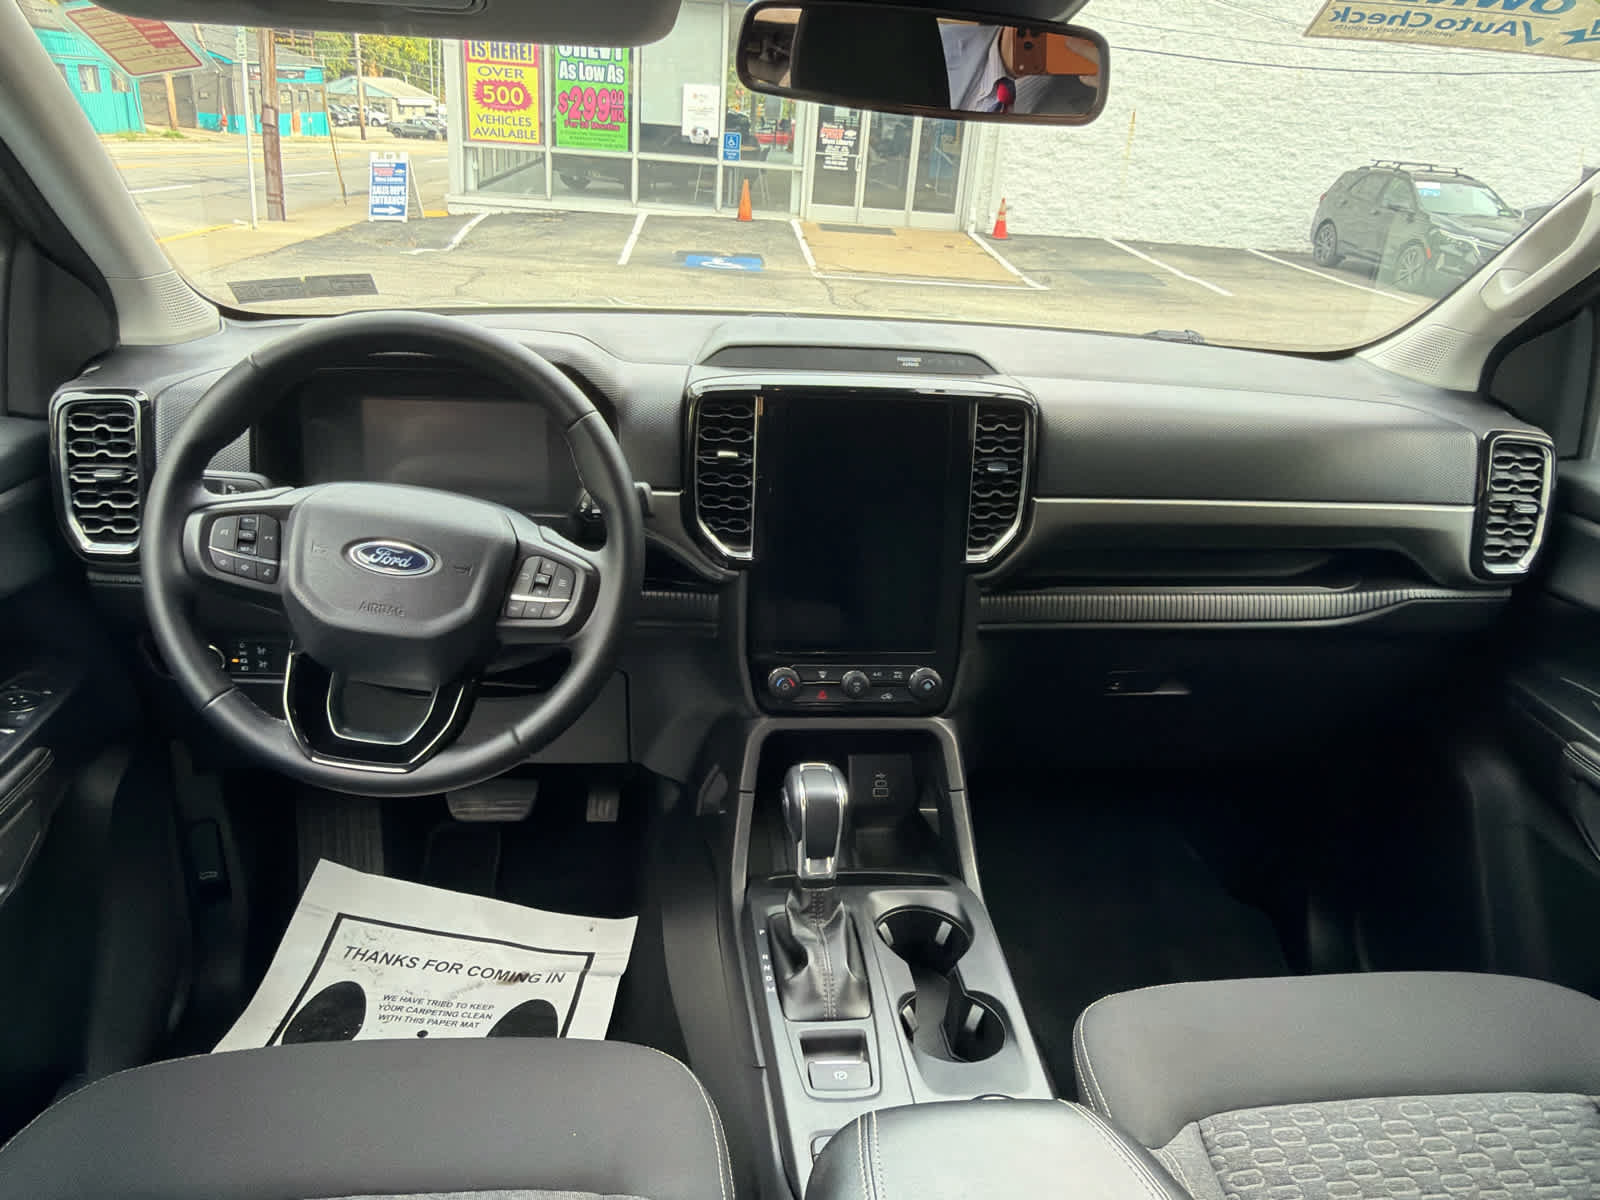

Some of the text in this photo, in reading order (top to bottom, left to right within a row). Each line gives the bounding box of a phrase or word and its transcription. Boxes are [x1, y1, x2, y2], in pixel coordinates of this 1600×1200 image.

[471, 40, 533, 61] IS HERE!
[477, 66, 524, 79] OVER
[482, 86, 524, 104] 500
[476, 113, 532, 127] VEHICLES
[473, 127, 537, 141] AVAILABLE
[369, 547, 413, 569] Ford
[359, 600, 405, 617] AIRBAG
[343, 945, 566, 984] THANKS FOR COMING IN
[383, 994, 496, 1011] WE HAVE TRIED TO KEEP
[378, 1004, 494, 1020] YOUR CARPETING CLEAN
[378, 1014, 403, 1022] WITH
[404, 1015, 425, 1025] THIS
[426, 1018, 458, 1028] PAPER
